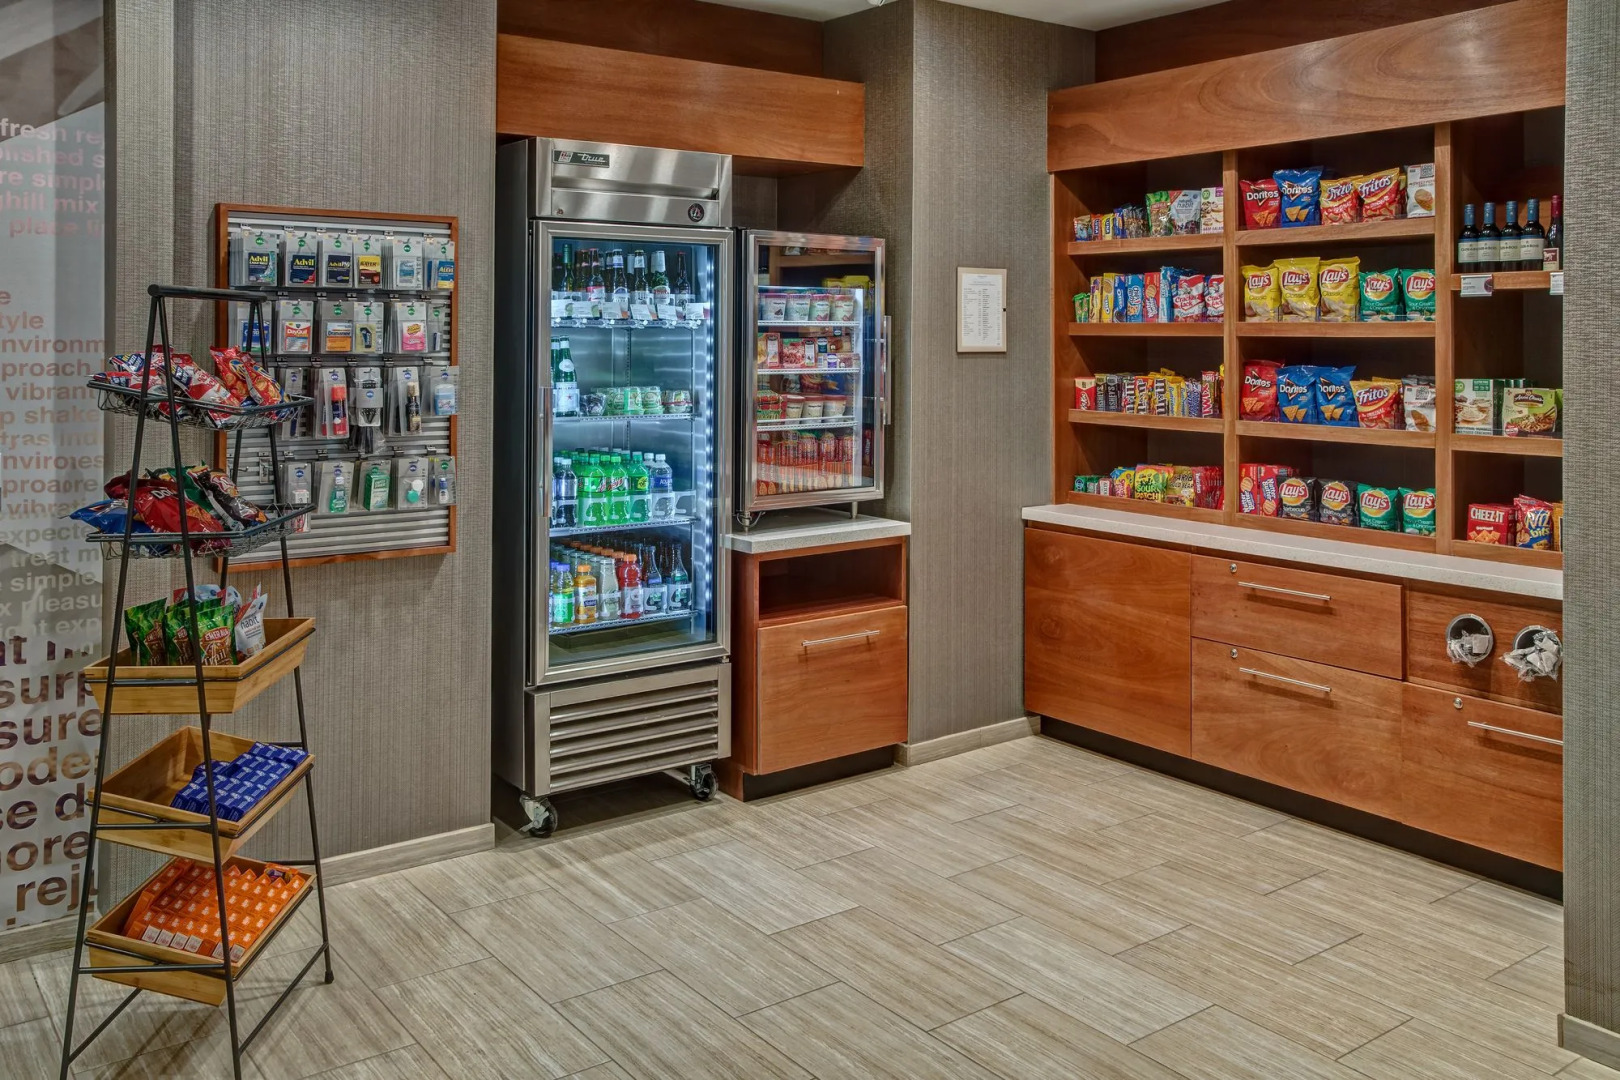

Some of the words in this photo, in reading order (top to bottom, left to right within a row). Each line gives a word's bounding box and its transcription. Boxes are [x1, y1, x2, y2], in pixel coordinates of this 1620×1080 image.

[1326, 182, 1353, 202] Fritos
[1358, 175, 1393, 198] Fritos
[1246, 190, 1279, 201] Doritos
[55, 195, 98, 213] mix
[294, 258, 315, 266] Advil
[1244, 375, 1271, 388] Doritos
[1279, 384, 1307, 394] Doritos
[1202, 383, 1213, 418] TWIX
[1356, 386, 1389, 405] Fritos
[1281, 484, 1305, 498] Lay's
[1361, 493, 1387, 509] Lay's
[1405, 494, 1433, 509] Lay's
